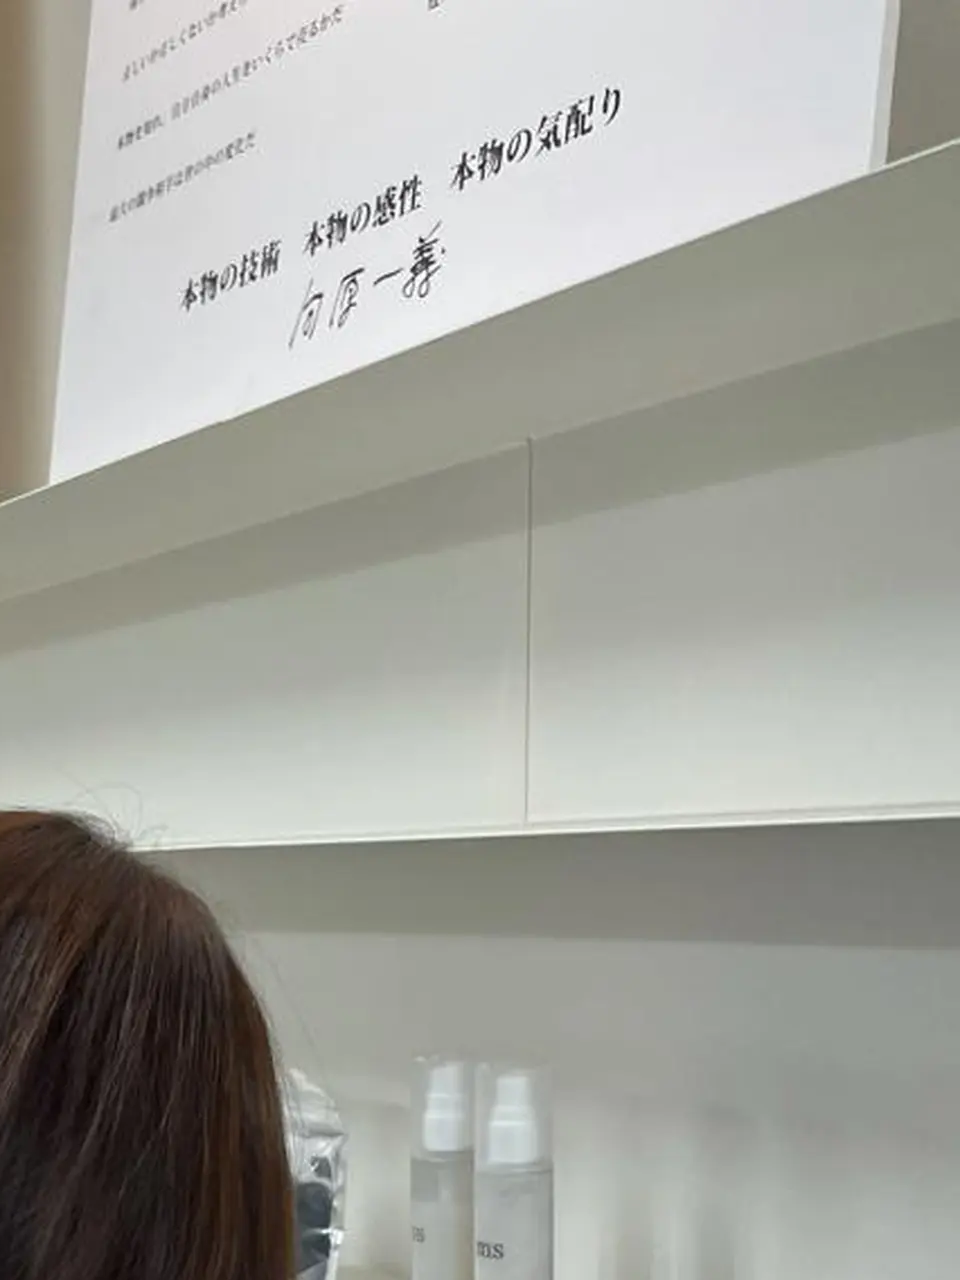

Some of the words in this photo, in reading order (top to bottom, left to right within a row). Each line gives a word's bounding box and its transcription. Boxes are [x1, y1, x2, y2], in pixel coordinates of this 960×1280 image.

[182, 240, 282, 313] 本物の技術
[304, 174, 423, 258] 本物の感性
[451, 87, 622, 191] 本物の気配り
